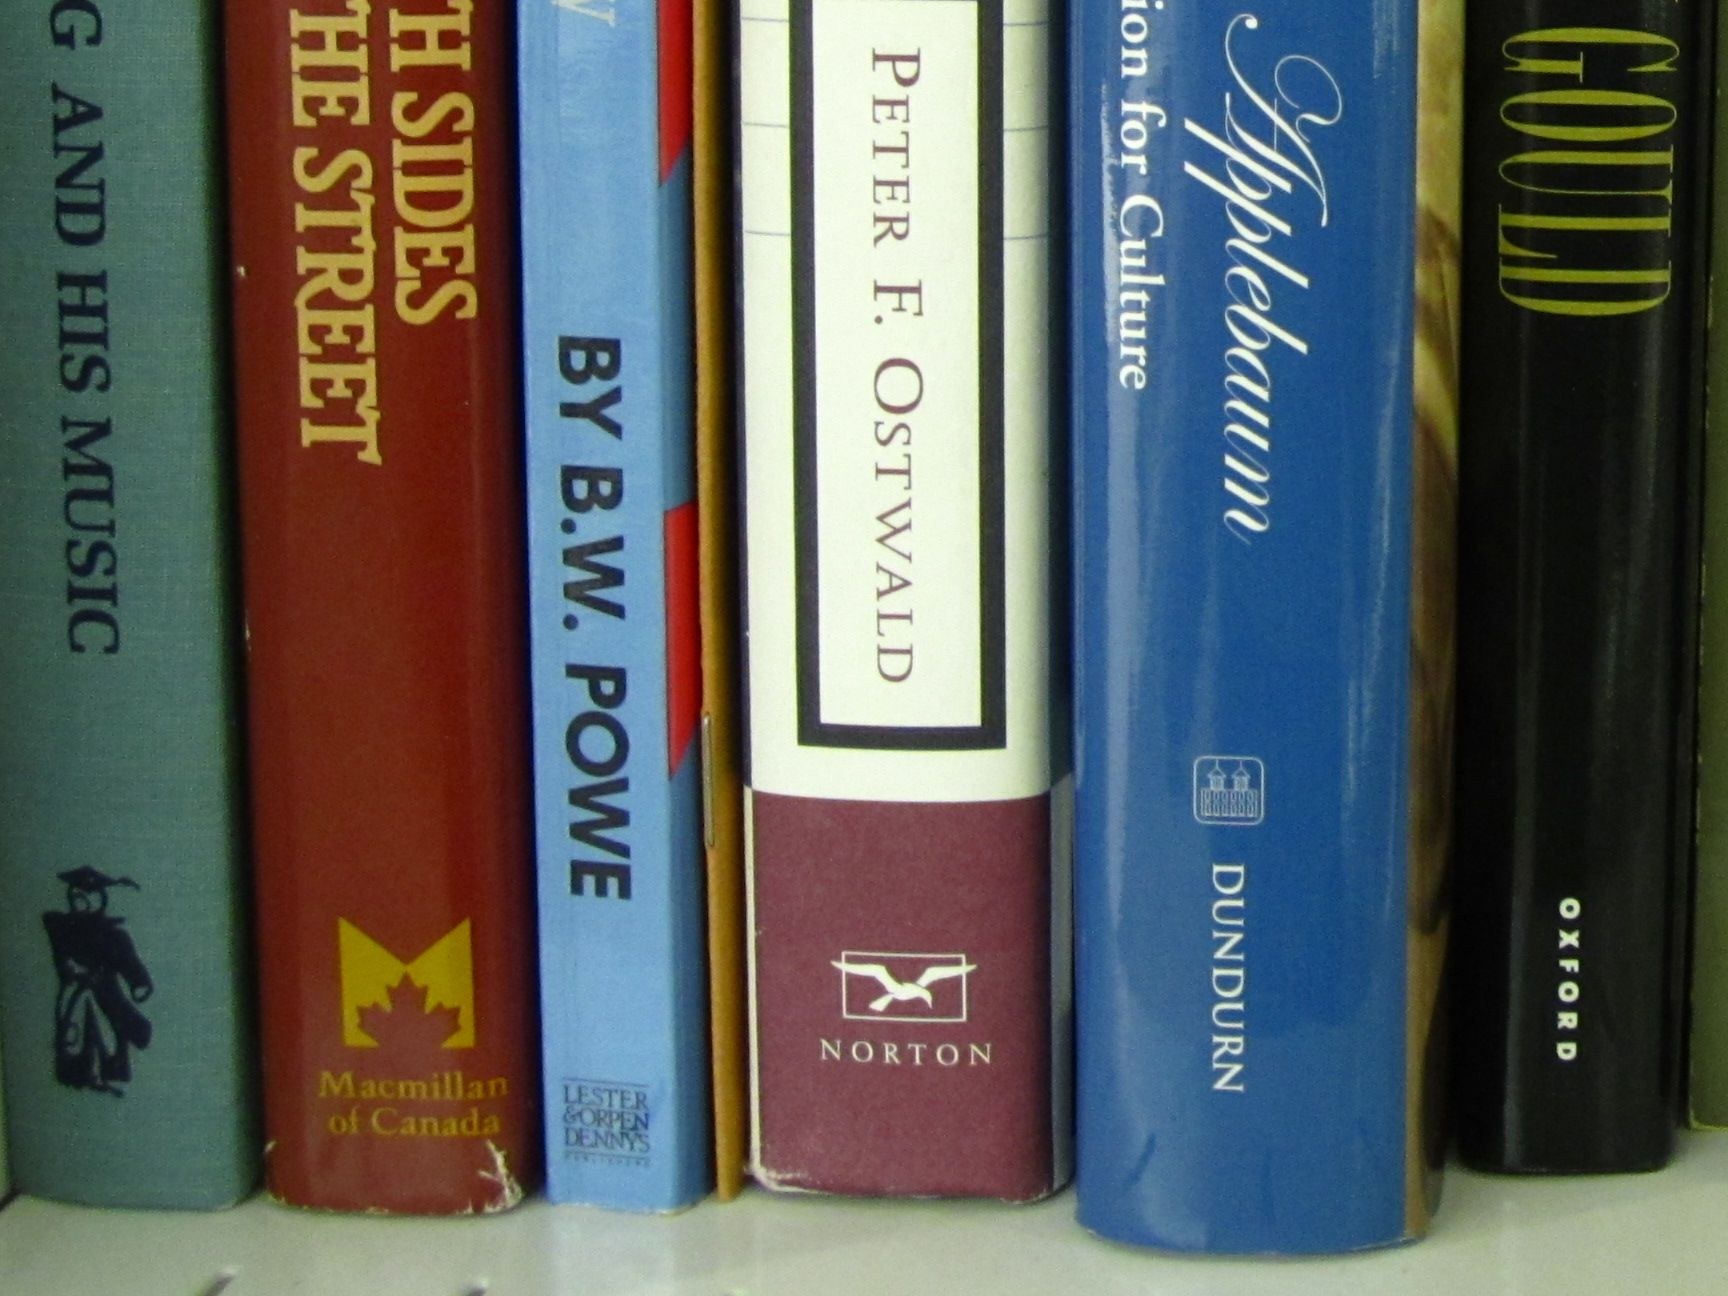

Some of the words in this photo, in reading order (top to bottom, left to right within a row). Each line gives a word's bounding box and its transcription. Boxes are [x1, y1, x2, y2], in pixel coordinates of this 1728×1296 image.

[51, 82, 106, 247] AND
[391, 92, 479, 326] SIDES
[872, 46, 921, 248] PETER
[1119, 99, 1166, 169] for
[1497, 26, 1681, 317] GOULD
[56, 273, 112, 393] HIS
[292, 147, 382, 466] STREET
[872, 278, 924, 326] F.
[1117, 192, 1165, 391] Culture
[1183, 12, 1343, 545] Applebaum
[557, 335, 624, 441] BY
[60, 416, 120, 653] MUSIC
[559, 464, 625, 631] B.W.
[873, 357, 924, 682] OSTWALD
[564, 663, 632, 901] POWE
[819, 1038, 993, 1066] NORTON
[1211, 863, 1246, 1093] DUNDURN
[1556, 898, 1580, 1062] OXFORD
[318, 1070, 508, 1100] Macmillan
[328, 1106, 358, 1135] of
[371, 1107, 500, 1137] Canada
[564, 1084, 648, 1110] LESTER
[564, 1126, 649, 1154] DENNYS
